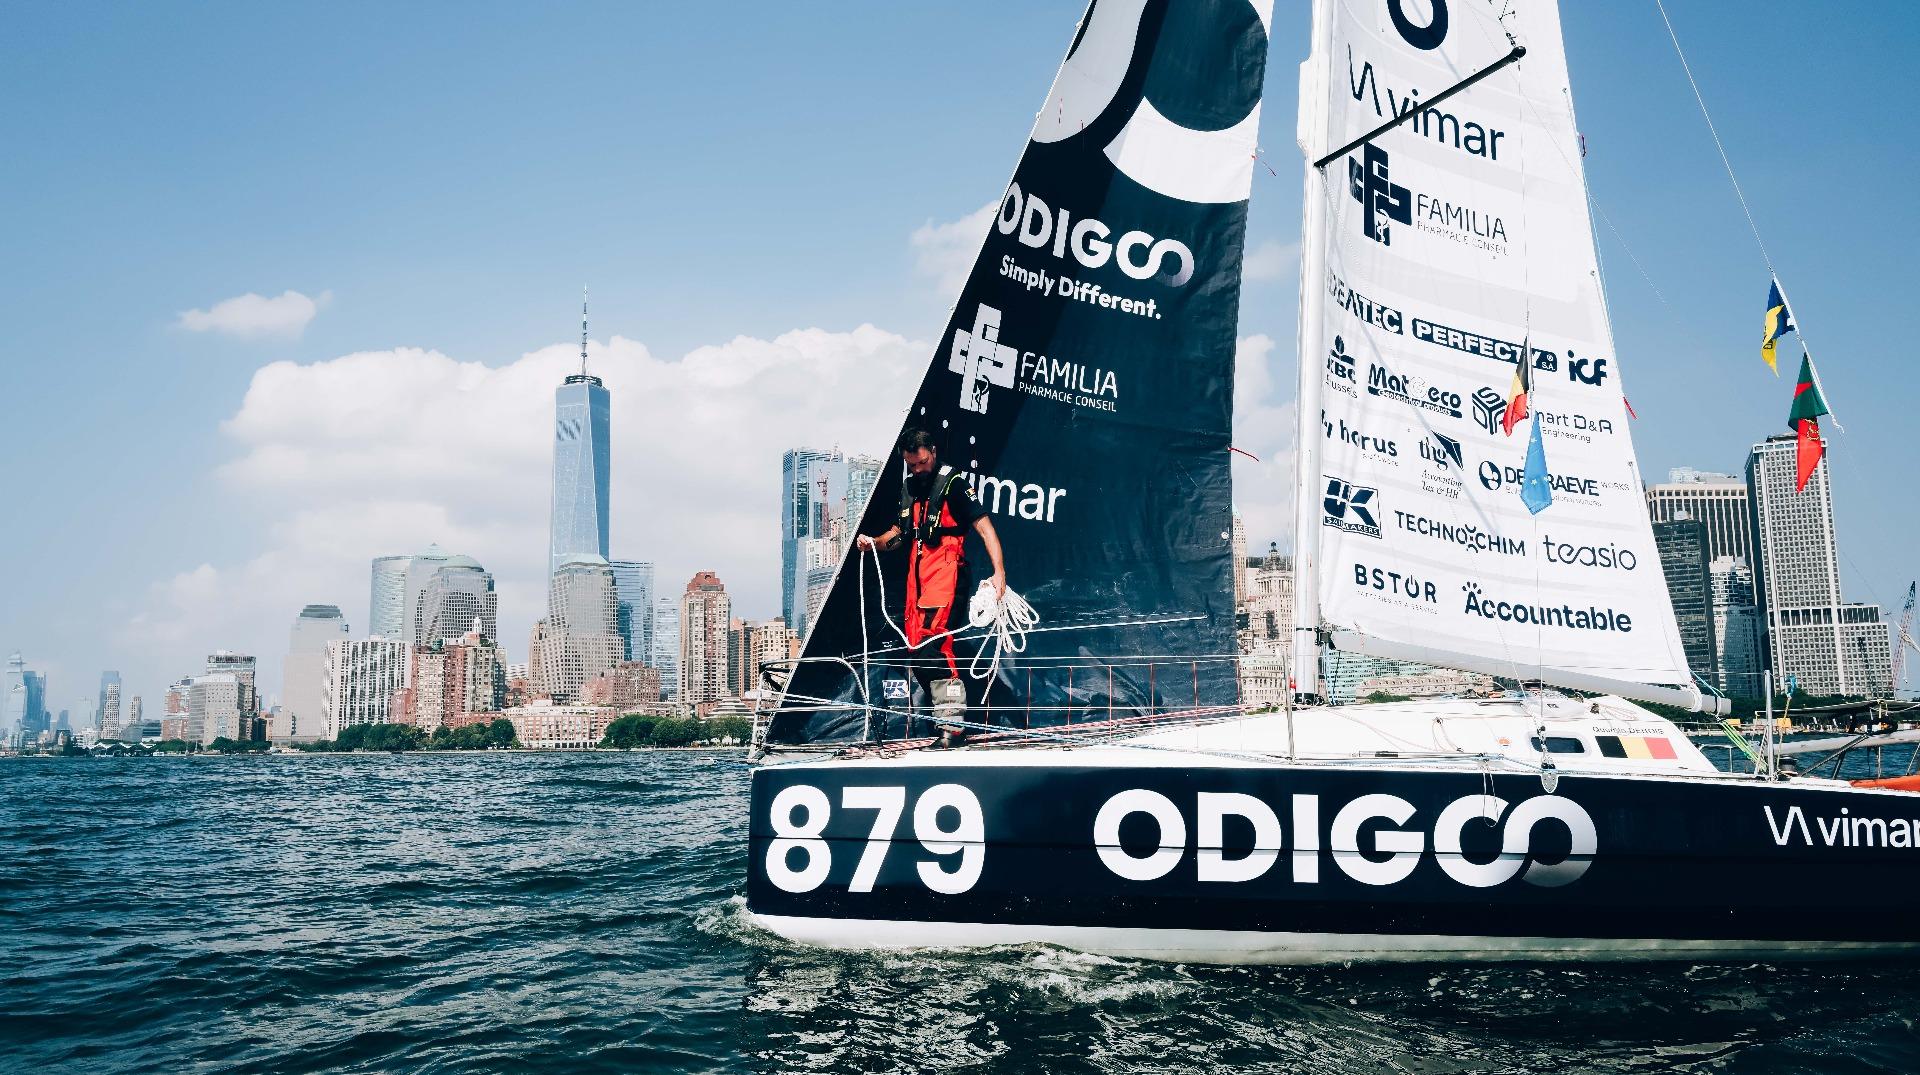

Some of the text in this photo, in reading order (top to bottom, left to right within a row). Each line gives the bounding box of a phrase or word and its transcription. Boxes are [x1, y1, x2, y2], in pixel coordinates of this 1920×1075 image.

[1417, 194, 1508, 242] FAMILIA
[1417, 220, 1468, 245] PHARMACE
[999, 254, 1162, 320] Simply Different.
[1020, 351, 1118, 398] FAMILIA
[1018, 381, 1117, 413] PHARMACIE CONSEIL
[1340, 419, 1398, 457] horus
[1542, 426, 1591, 443] Engineering
[960, 459, 1067, 523] imar
[1504, 466, 1600, 497] DERAEVE
[1543, 535, 1637, 571] teasio
[1464, 588, 1632, 632] Accountable
[766, 785, 985, 894] 879
